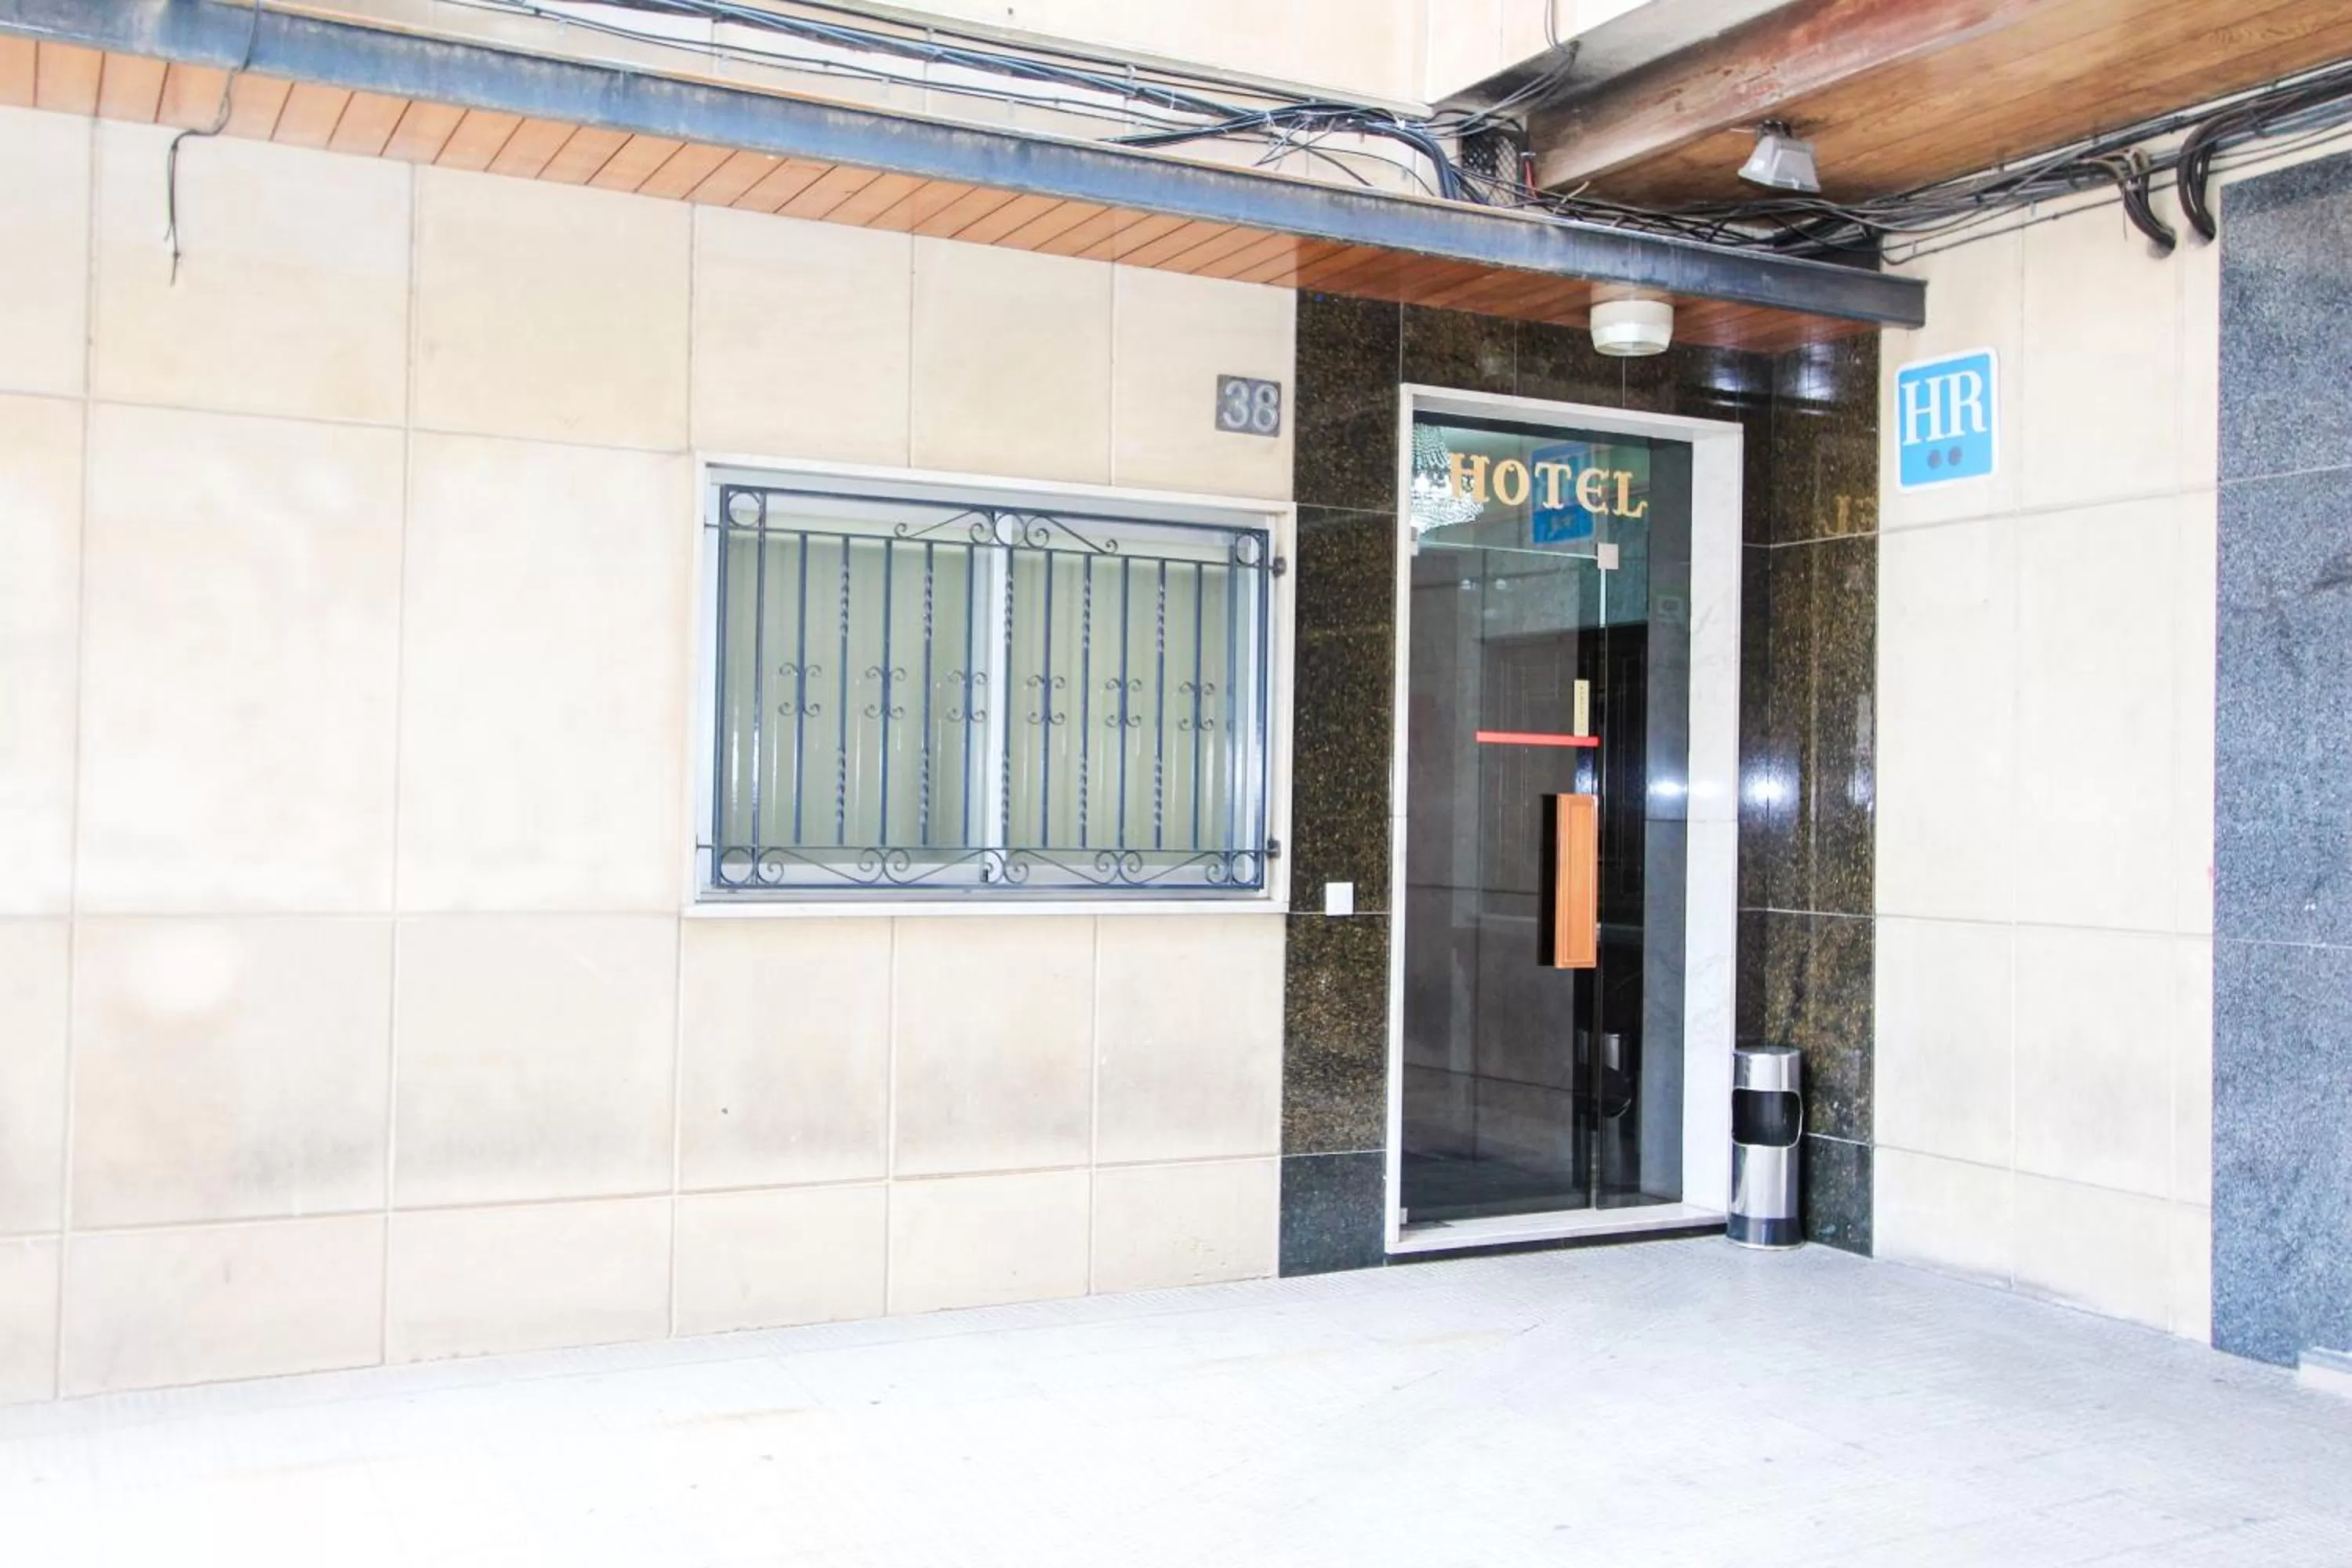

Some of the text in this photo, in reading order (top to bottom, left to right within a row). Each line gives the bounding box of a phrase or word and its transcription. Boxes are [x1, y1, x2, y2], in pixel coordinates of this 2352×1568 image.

[1223, 380, 1278, 432] 38
[1900, 370, 1987, 445] HR
[1448, 452, 1648, 518] HOTEL
